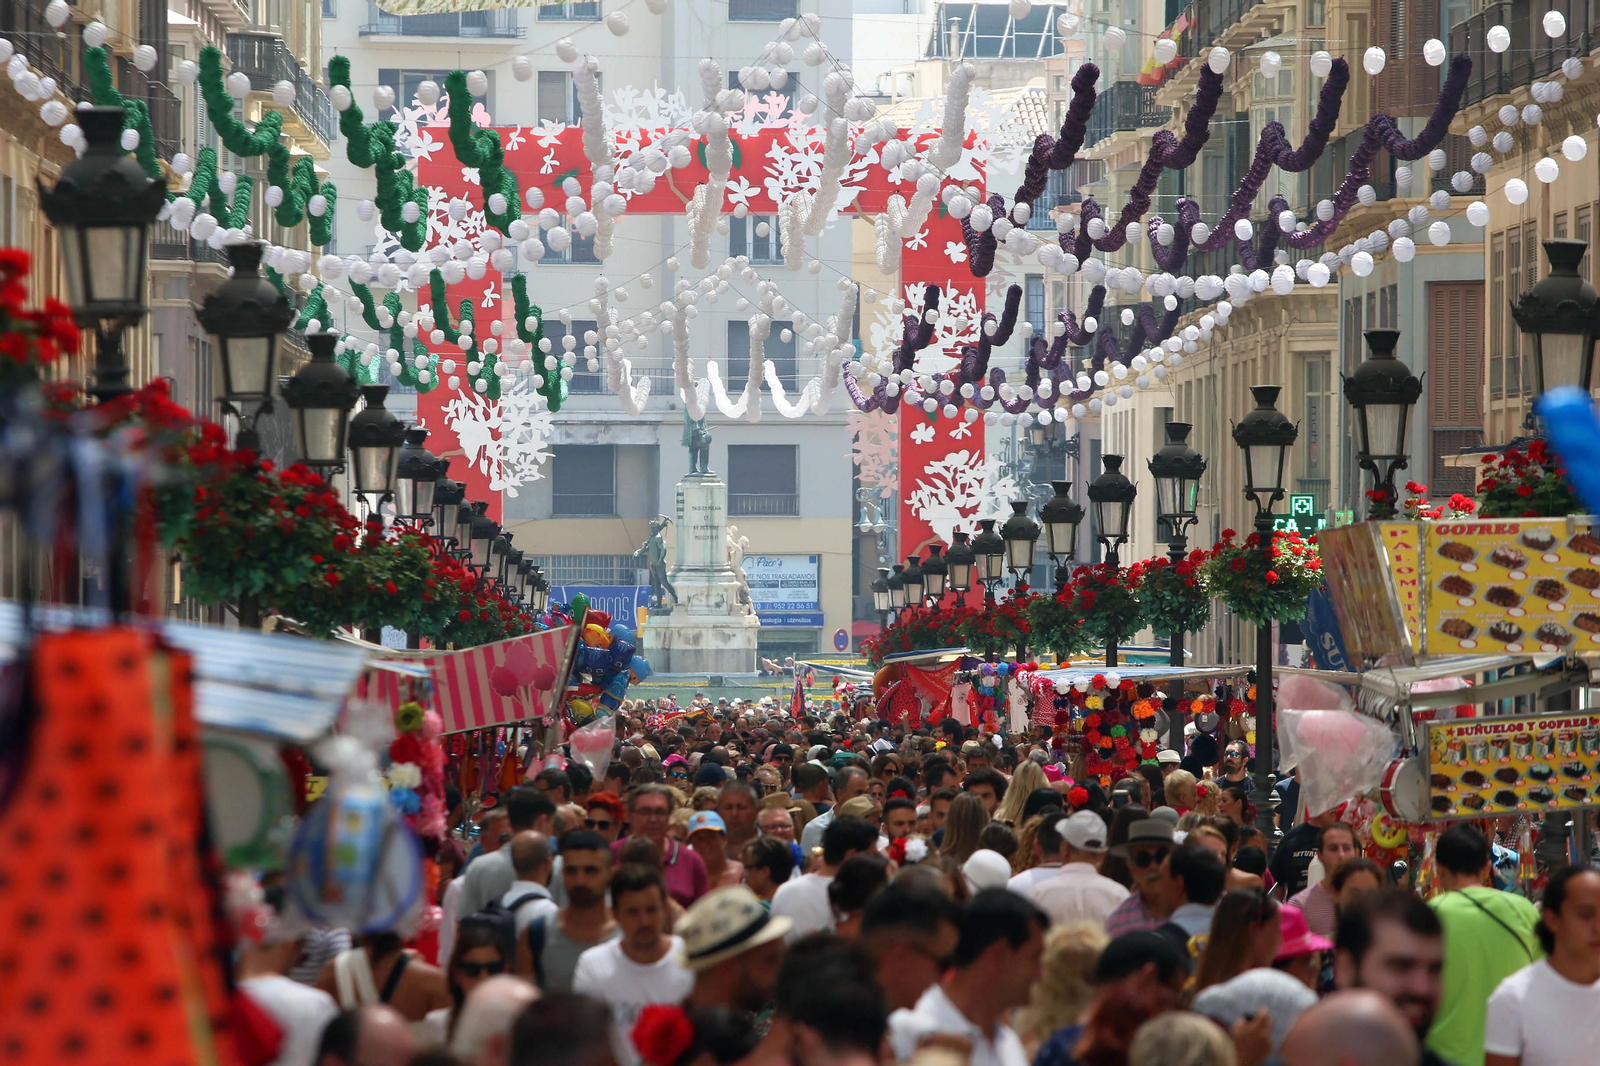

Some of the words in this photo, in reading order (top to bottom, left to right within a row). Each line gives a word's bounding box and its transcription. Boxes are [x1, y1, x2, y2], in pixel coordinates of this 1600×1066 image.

[1435, 523, 1520, 535] GOFRES
[1389, 529, 1418, 636] PALOMITAS
[1456, 724, 1524, 736] BUÑUELOS
[1526, 722, 1536, 731] Y
[1538, 718, 1588, 730] GOFRES
